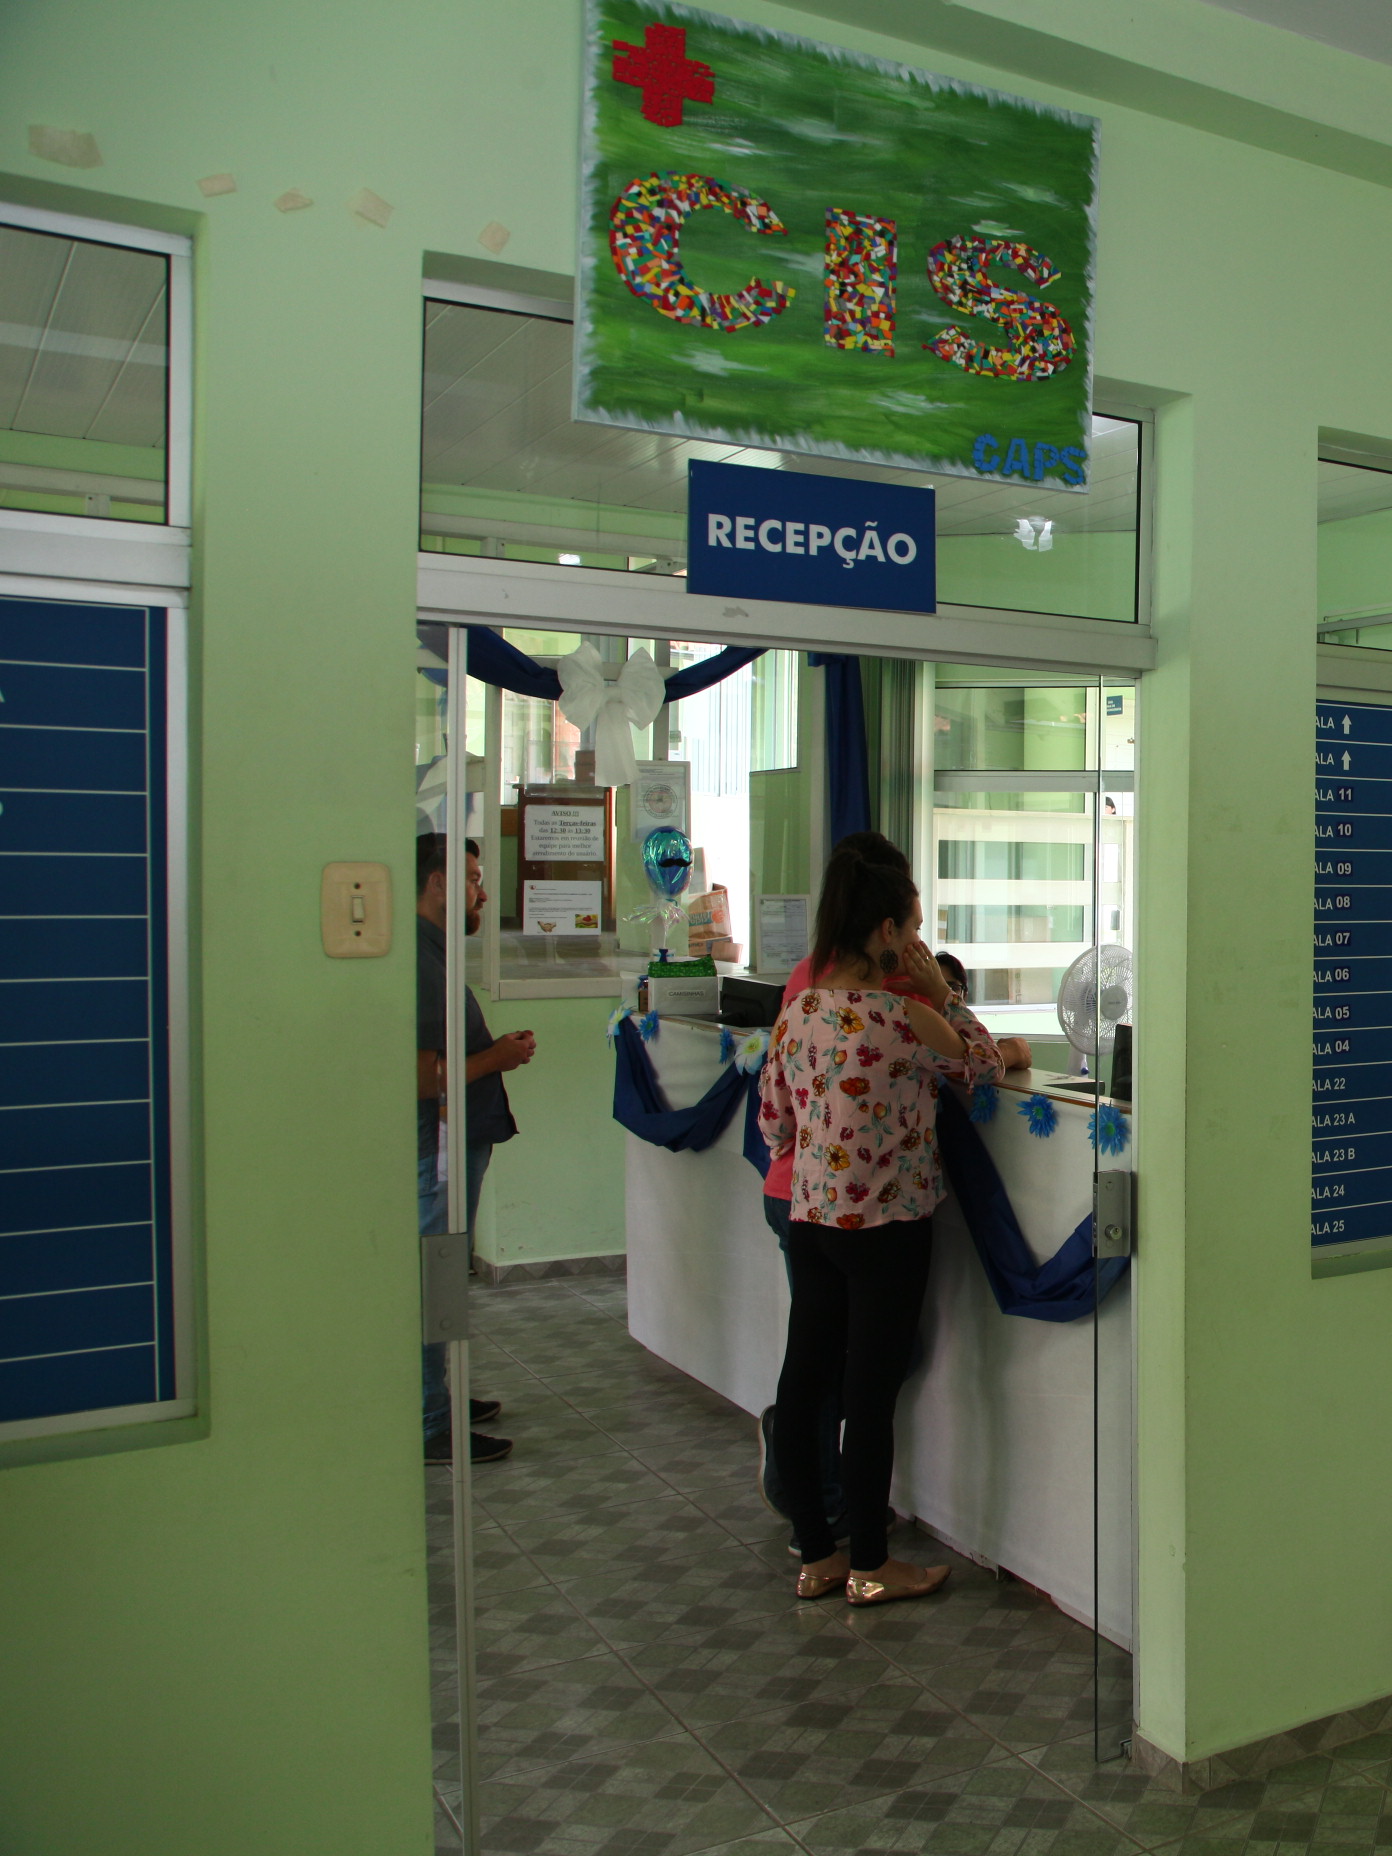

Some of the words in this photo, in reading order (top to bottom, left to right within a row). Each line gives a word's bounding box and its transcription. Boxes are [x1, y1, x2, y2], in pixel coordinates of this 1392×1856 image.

[609, 170, 1078, 383] CIS
[972, 433, 1088, 486] CAPS
[707, 513, 918, 569] RECEPÇÃO
[1315, 715, 1335, 729] ALA
[1315, 752, 1335, 765] ALA
[1315, 789, 1334, 802] ALA
[1338, 788, 1352, 801] 11
[1314, 825, 1334, 838] ALA
[1337, 824, 1352, 836] 10
[1314, 862, 1333, 874] ALA
[1337, 862, 1352, 875] 09
[1314, 898, 1333, 910] ALA
[1336, 896, 1351, 908] 08
[1313, 934, 1333, 946] ALA
[1335, 932, 1350, 945] 07
[1313, 970, 1333, 983] ALA
[1335, 968, 1350, 980] 06
[1313, 1006, 1332, 1019] ALA
[1335, 1006, 1350, 1019] 05
[1312, 1043, 1332, 1055] ALA
[1335, 1040, 1350, 1053] 04
[1311, 1079, 1331, 1092] ALA
[1333, 1077, 1346, 1090] 22
[1311, 1114, 1331, 1128] ALA
[1333, 1113, 1346, 1126] 23
[1347, 1112, 1356, 1124] A
[1311, 1150, 1331, 1164] ALA
[1333, 1149, 1345, 1162] 23
[1347, 1148, 1355, 1160] B
[1311, 1186, 1331, 1200] ALA
[1333, 1184, 1345, 1197] 24
[1310, 1222, 1331, 1235] ALA
[1333, 1220, 1345, 1233] 25
